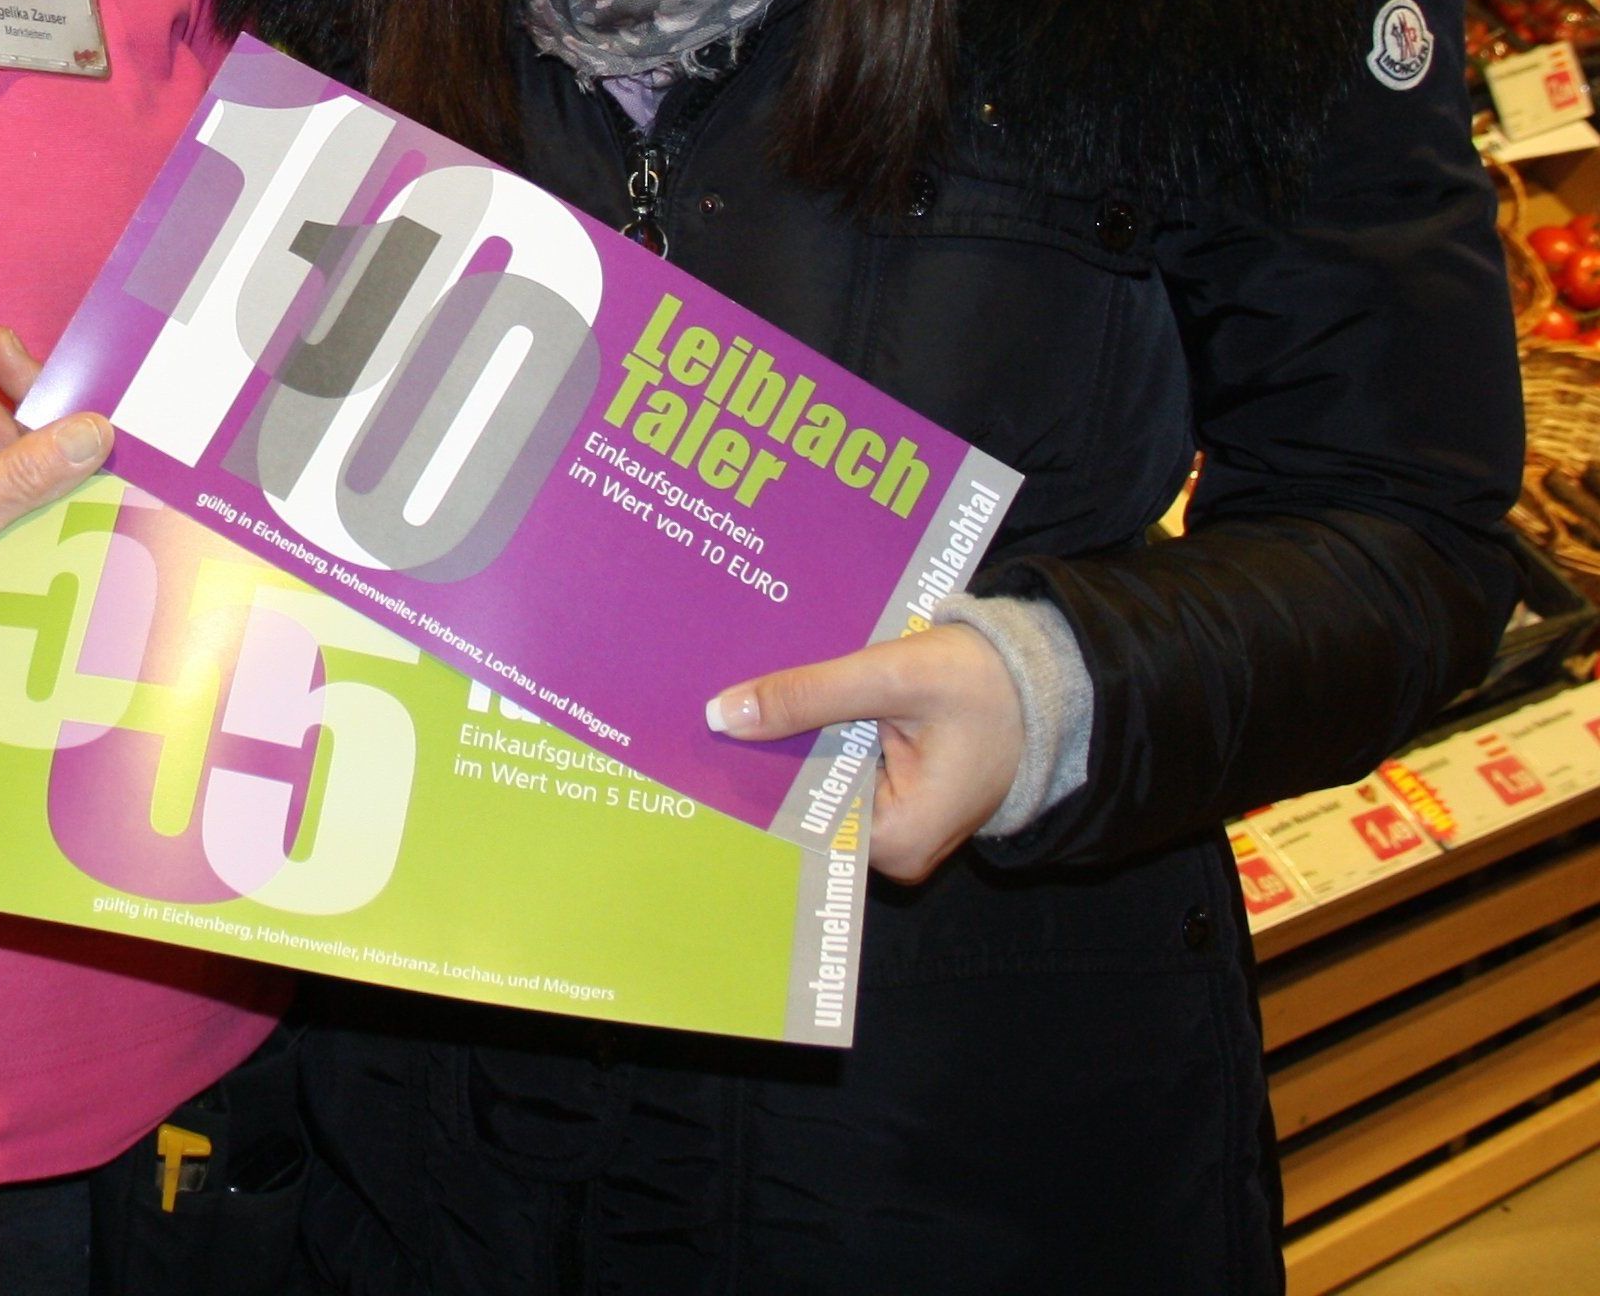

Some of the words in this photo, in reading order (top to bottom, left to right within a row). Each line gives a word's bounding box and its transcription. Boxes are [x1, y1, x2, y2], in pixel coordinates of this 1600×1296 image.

[30, 7, 67, 26] Zauser
[603, 352, 788, 508] Taler
[632, 292, 931, 520] Leiblach
[568, 459, 598, 488] im
[602, 477, 654, 521] Wert
[656, 515, 694, 547] von
[700, 539, 725, 566] 10
[726, 556, 790, 604] EURO
[584, 432, 766, 555] Einkaufsgutschein
[196, 493, 238, 524] gültig
[237, 511, 253, 529] in
[252, 521, 328, 575] Eichenberg,
[330, 563, 418, 625] Hohenweiler,
[417, 613, 484, 664] Hörbranz,
[484, 652, 537, 695] Lochau,
[539, 687, 570, 711] und
[568, 702, 633, 748] Möggers
[454, 754, 482, 779] im
[492, 761, 548, 794] Wert
[555, 779, 597, 803] von
[606, 788, 619, 806] 5
[628, 790, 696, 819] EURO
[93, 897, 139, 919] gültig
[144, 903, 158, 920] in
[162, 907, 253, 941] Eichenberg,
[257, 926, 360, 962] Hohenweiler,
[363, 947, 440, 975] Hörbranz,
[443, 962, 504, 986] Lochau,
[508, 975, 540, 991] und
[543, 978, 615, 1002] Möggers
